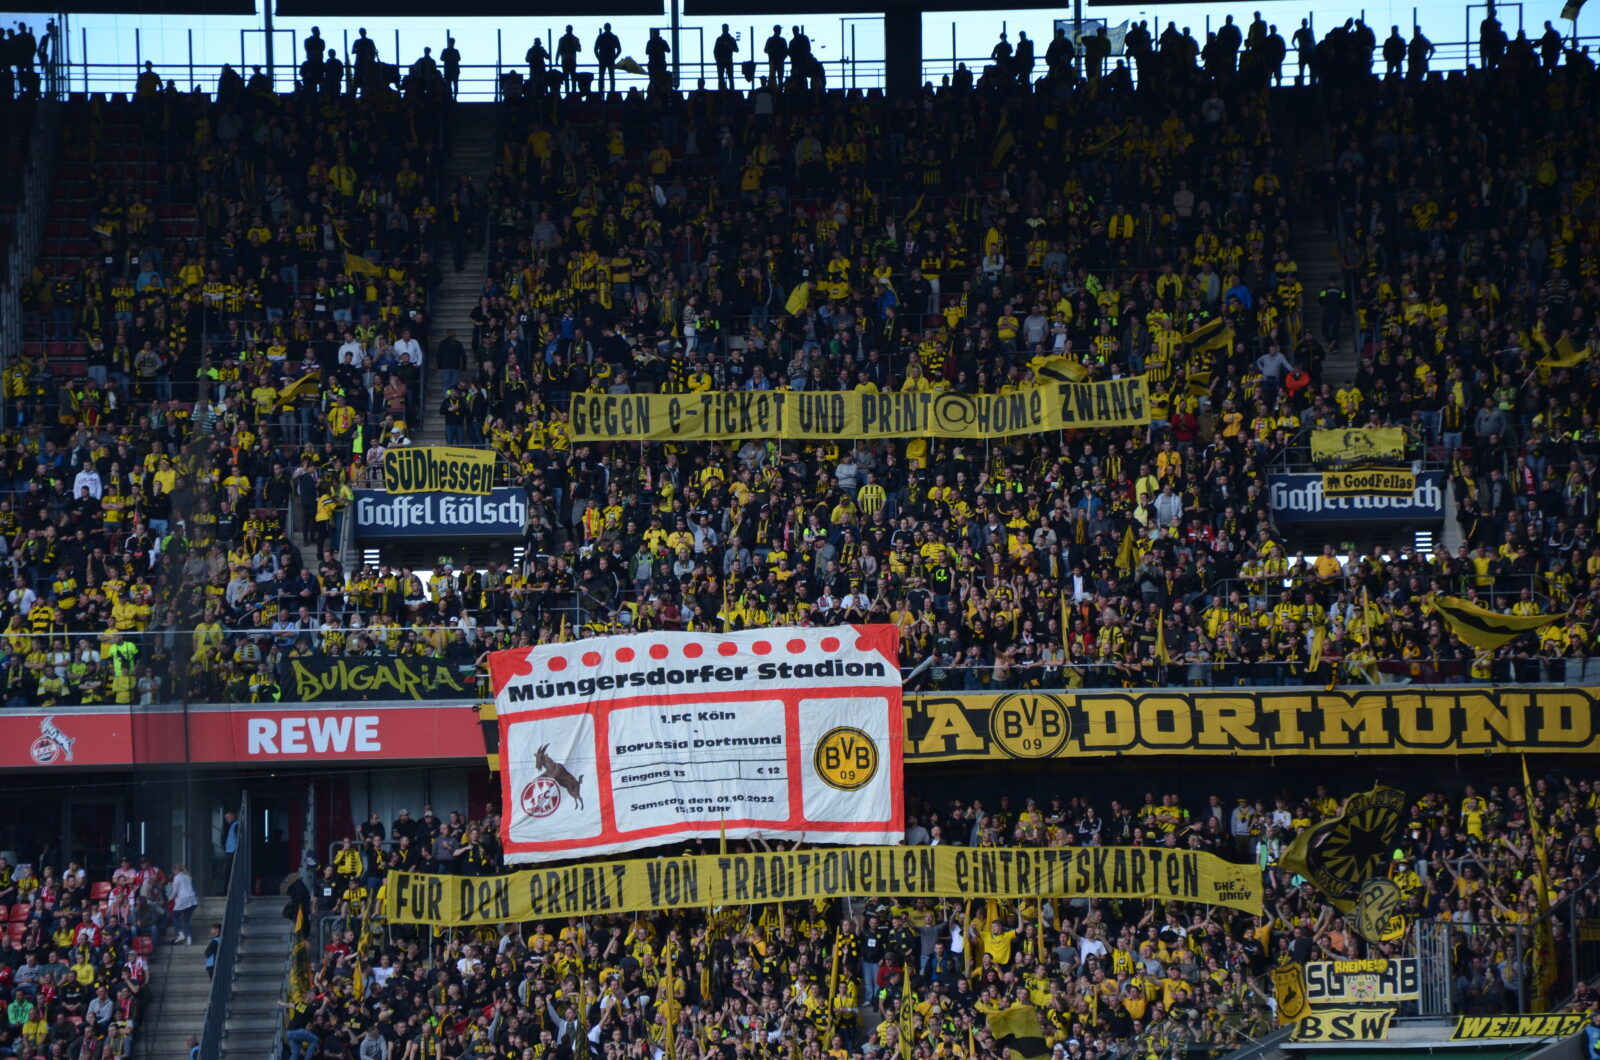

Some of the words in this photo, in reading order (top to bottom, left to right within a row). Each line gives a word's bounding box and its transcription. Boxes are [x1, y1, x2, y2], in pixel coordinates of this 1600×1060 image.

[799, 393, 845, 434] UND
[1058, 379, 1144, 422] ZWANG
[1271, 480, 1350, 512] Gaff
[1343, 474, 1413, 489] GoodFellas
[357, 496, 435, 528] Gaffel
[439, 495, 525, 528] Kölsch
[508, 664, 748, 702] Müngersdorfer
[758, 659, 885, 680] Stadion
[698, 711, 736, 722] Köln
[1003, 698, 1061, 739] BVB
[1078, 691, 1597, 750] DORTMUND
[247, 715, 381, 755] REWE
[616, 740, 688, 755] Borussia
[694, 735, 782, 748] Dortmund
[1022, 738, 1042, 750] 09
[825, 736, 870, 769] BVB
[621, 770, 671, 783] Eingang
[840, 770, 856, 780] 09
[630, 797, 685, 812] Samstag
[688, 796, 713, 804] den
[717, 794, 775, 803] 01.10.2022
[675, 805, 704, 814] 15:30
[708, 804, 731, 813] Uhr
[396, 874, 442, 921] FÜR
[646, 859, 698, 906] VON
[1298, 1011, 1390, 1040] BSW
